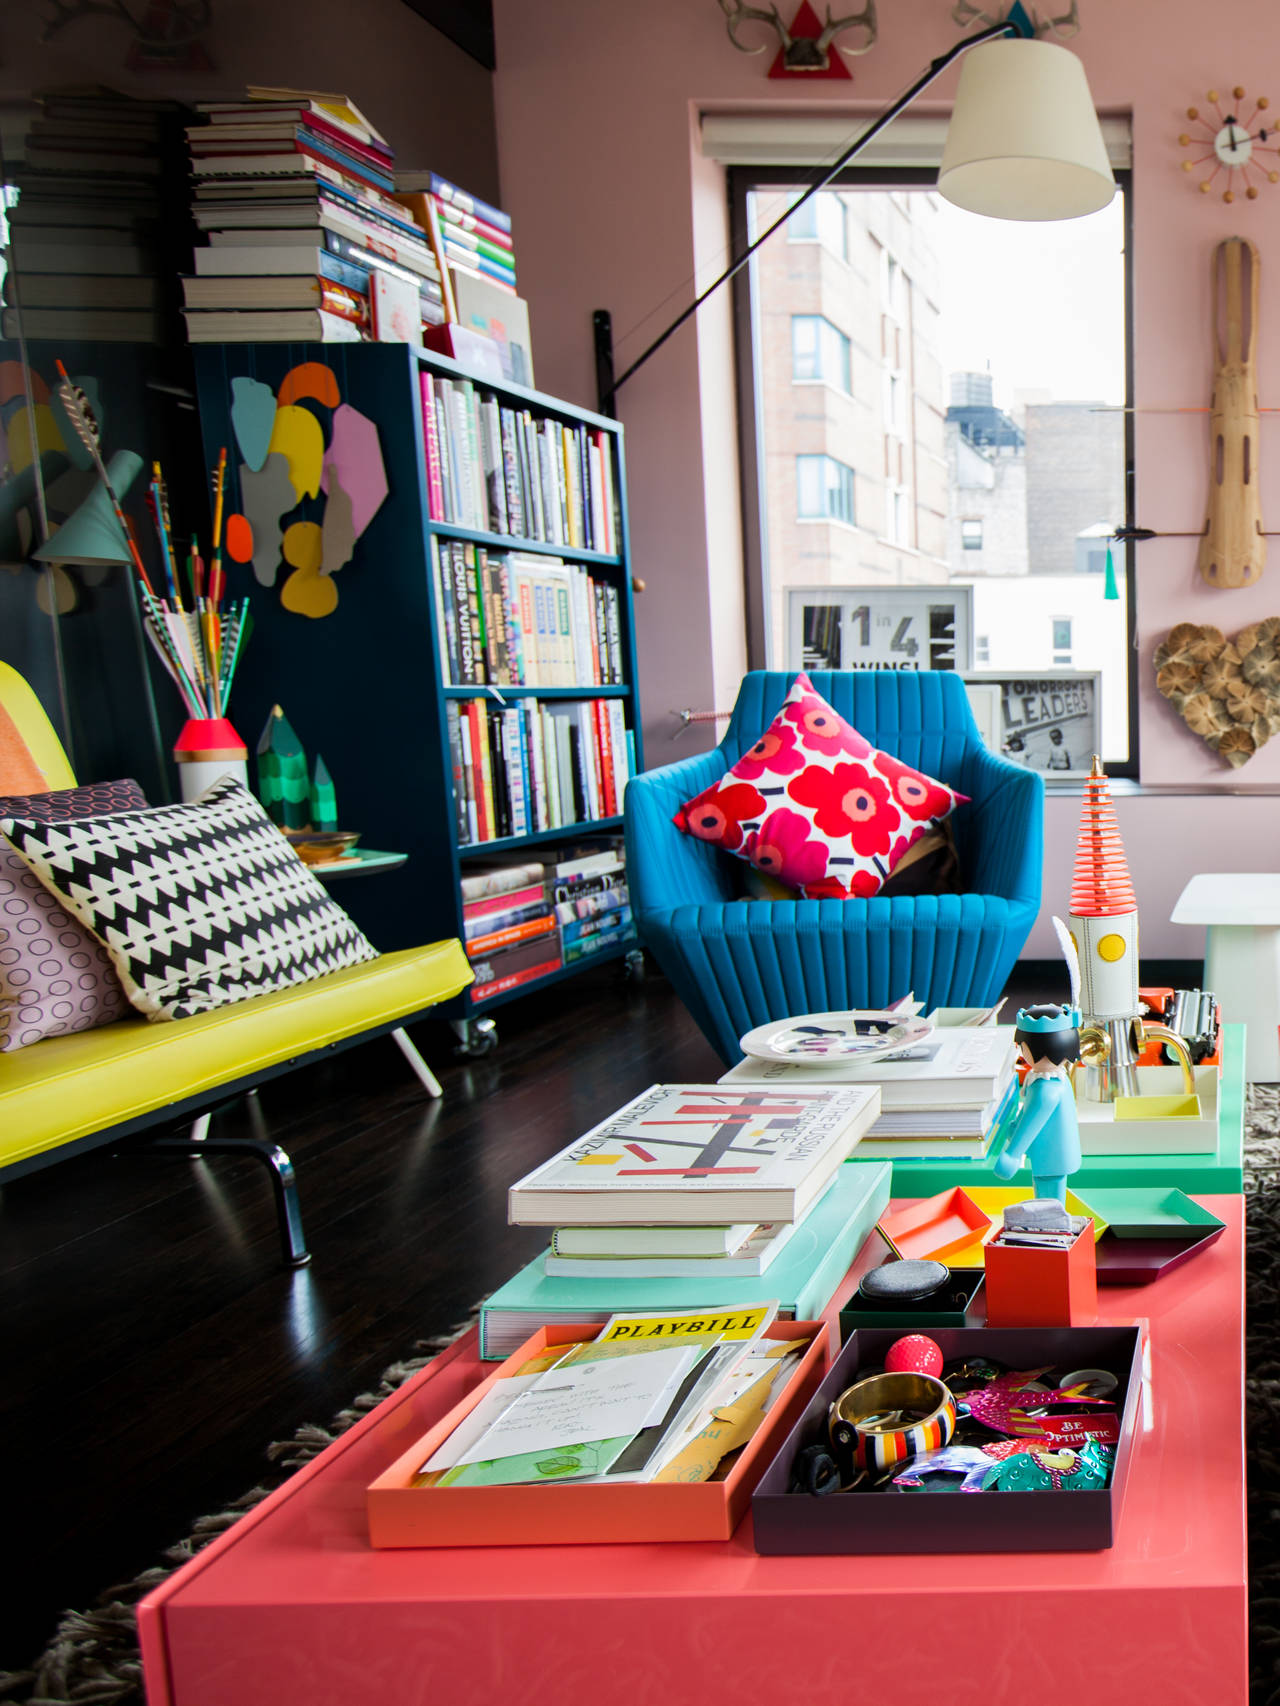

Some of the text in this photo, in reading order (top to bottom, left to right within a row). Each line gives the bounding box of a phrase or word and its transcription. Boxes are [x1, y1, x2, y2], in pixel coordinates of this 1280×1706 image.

[453, 554, 468, 601] LOUIS
[851, 605, 871, 647] 1
[890, 616, 920, 658] 4
[1001, 692, 1088, 728] LEADERS
[609, 1315, 758, 1339] PLAYBILL
[1045, 1430, 1112, 1443] OPTIMSTIC
[1061, 1421, 1084, 1432] BE
